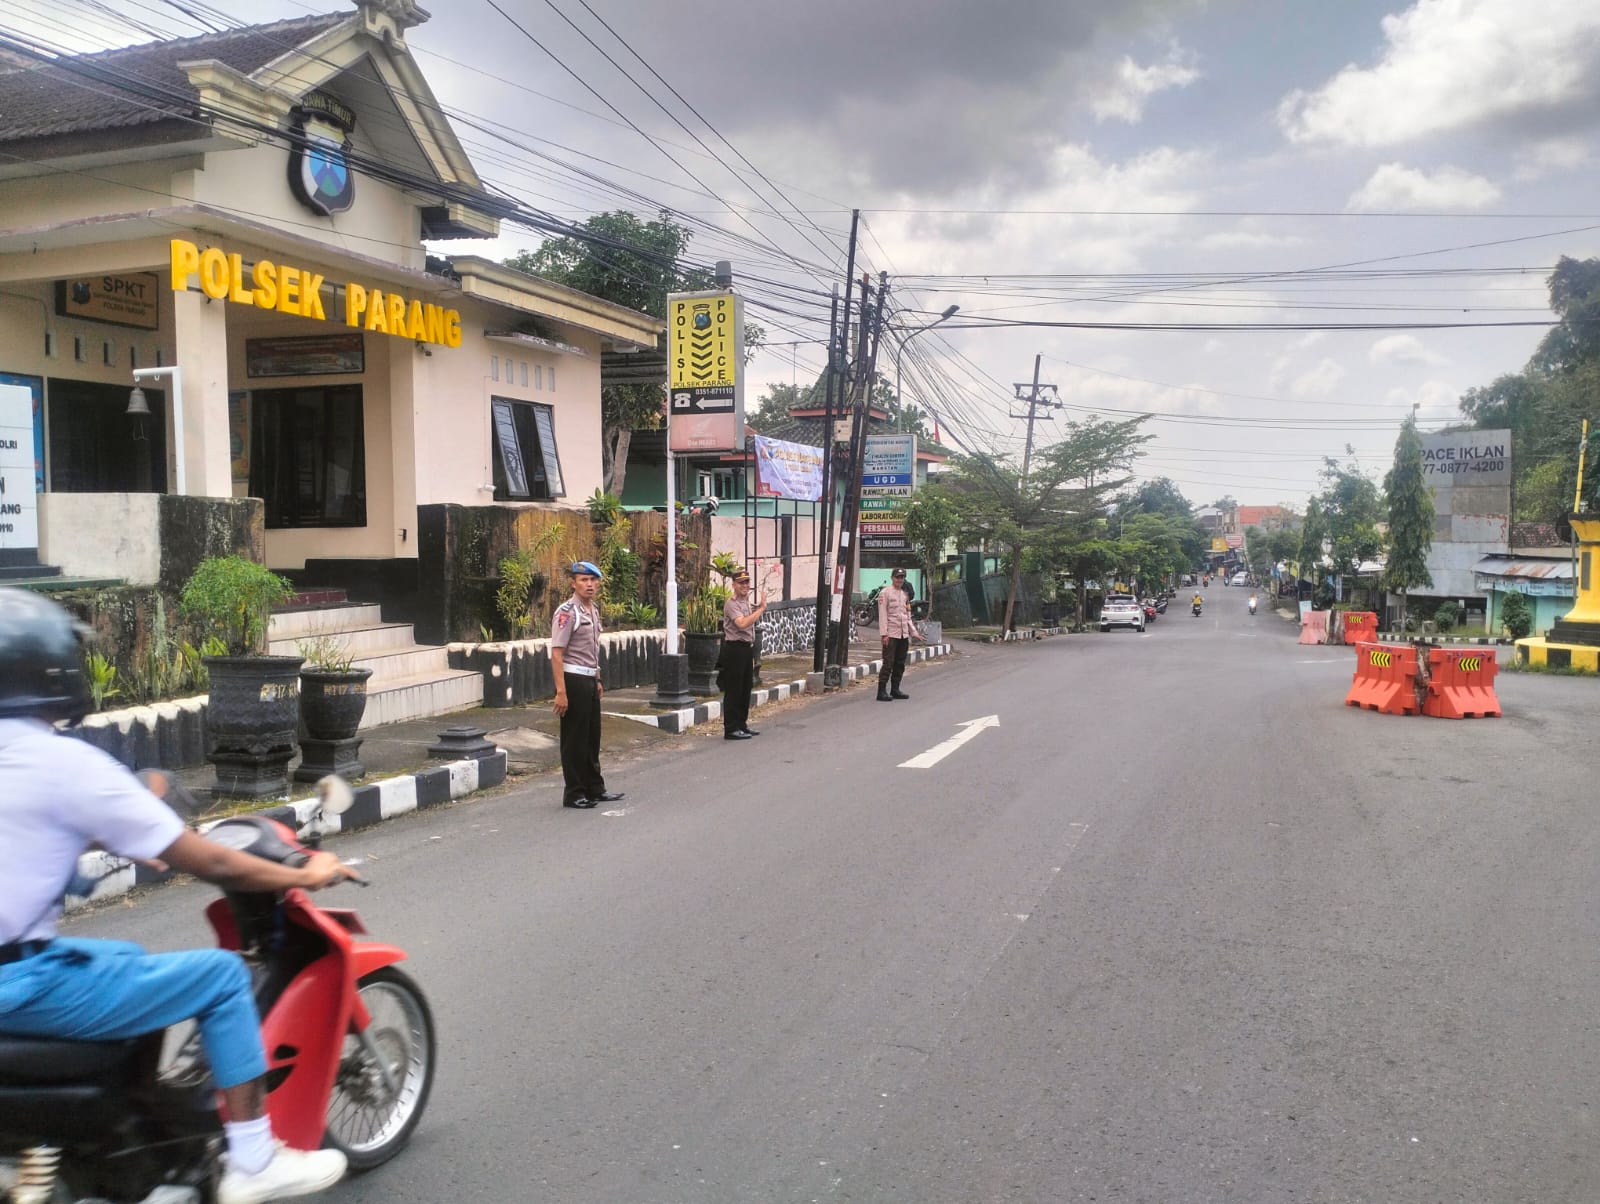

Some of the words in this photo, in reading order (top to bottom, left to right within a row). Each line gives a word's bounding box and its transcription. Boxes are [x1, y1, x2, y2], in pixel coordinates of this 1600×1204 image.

[103, 276, 146, 299] SPKT
[171, 239, 326, 321] POLSEK
[345, 282, 463, 348] PARANG
[676, 303, 686, 382] POLISI
[716, 300, 727, 380] POLICE
[673, 381, 700, 389] POLSEK
[702, 379, 732, 387] PARANG
[1460, 445, 1504, 459] IKLAN
[874, 476, 896, 484] UGD
